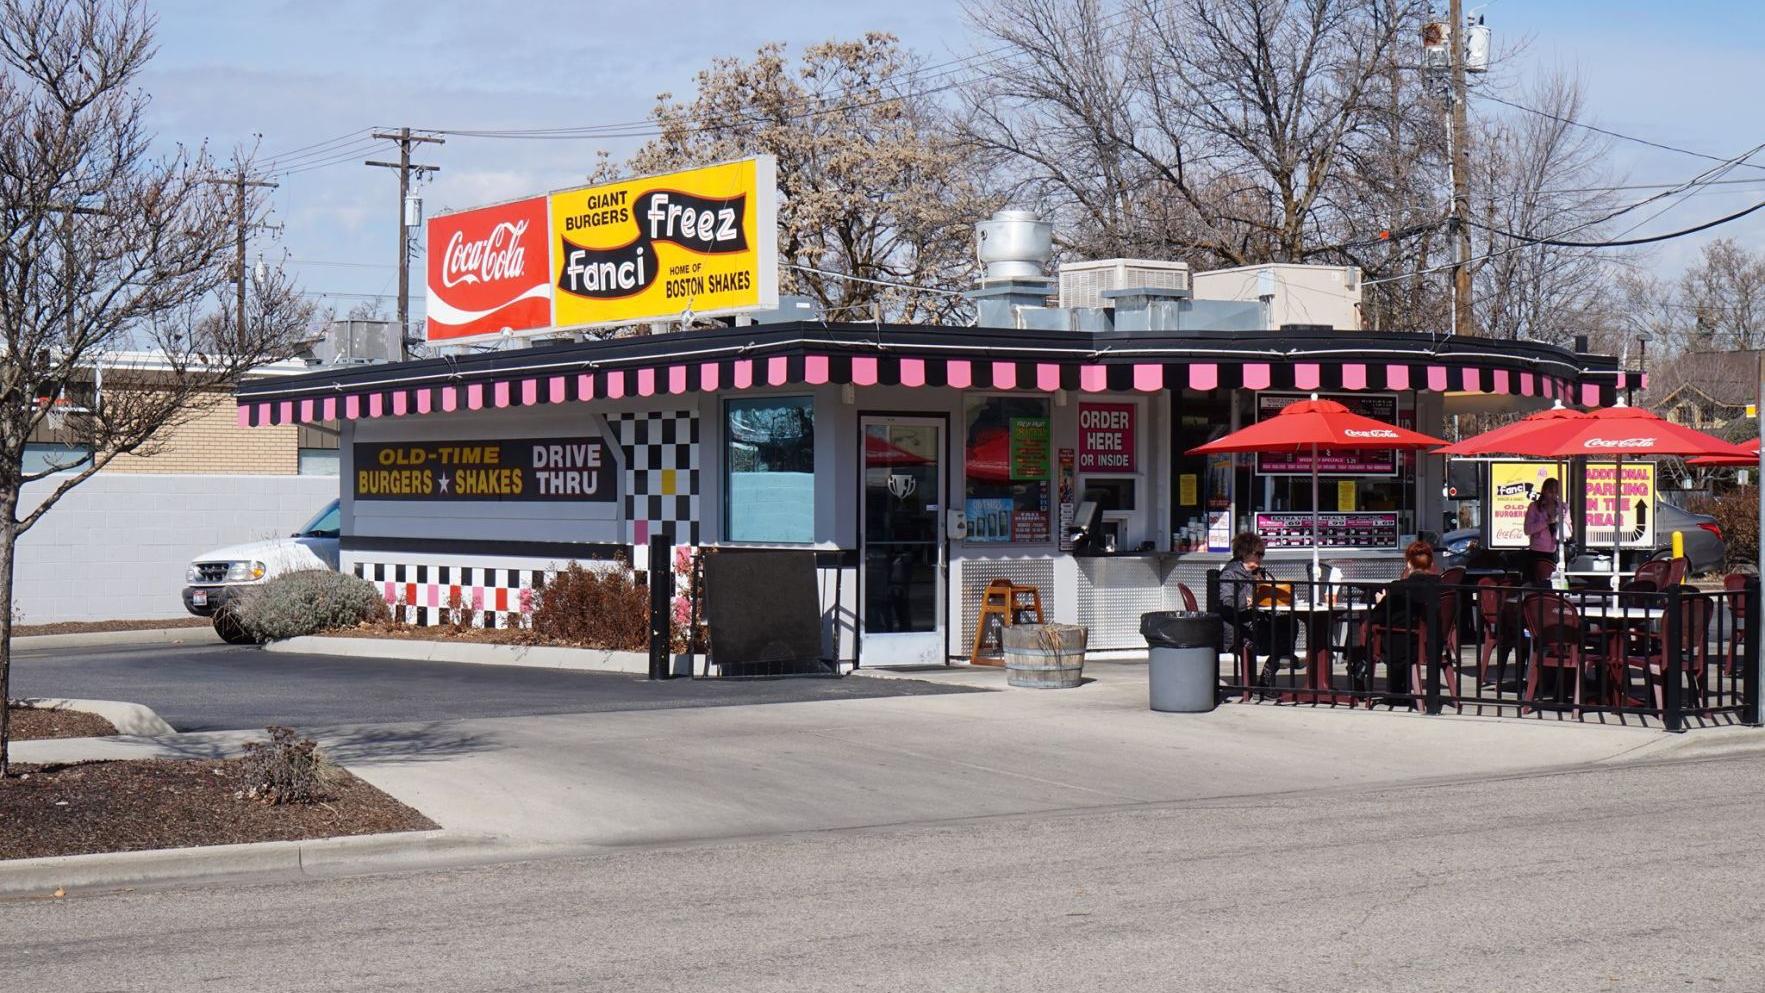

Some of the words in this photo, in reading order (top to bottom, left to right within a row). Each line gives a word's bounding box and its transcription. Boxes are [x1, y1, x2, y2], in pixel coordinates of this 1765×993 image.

[587, 190, 628, 210] GIANT
[565, 208, 629, 231] BURGERS
[647, 193, 738, 242] freez
[443, 218, 530, 288] Coca-Cola
[567, 247, 645, 292] fanci
[669, 265, 690, 275] HOME
[692, 263, 702, 273] OF
[666, 277, 704, 299] BOSTON
[708, 270, 750, 294] SHAKES
[1080, 410, 1129, 430] ORDER
[1087, 432, 1123, 451] HERE
[378, 447, 500, 466] OLD-TIME
[532, 444, 601, 469] DRIVE
[1080, 454, 1094, 467] OR
[1098, 453, 1129, 467] INSIDE
[358, 468, 433, 495] BURGERS
[455, 468, 523, 495] SHAKES
[536, 470, 599, 496] THRU
[1495, 510, 1527, 518] BURGER
